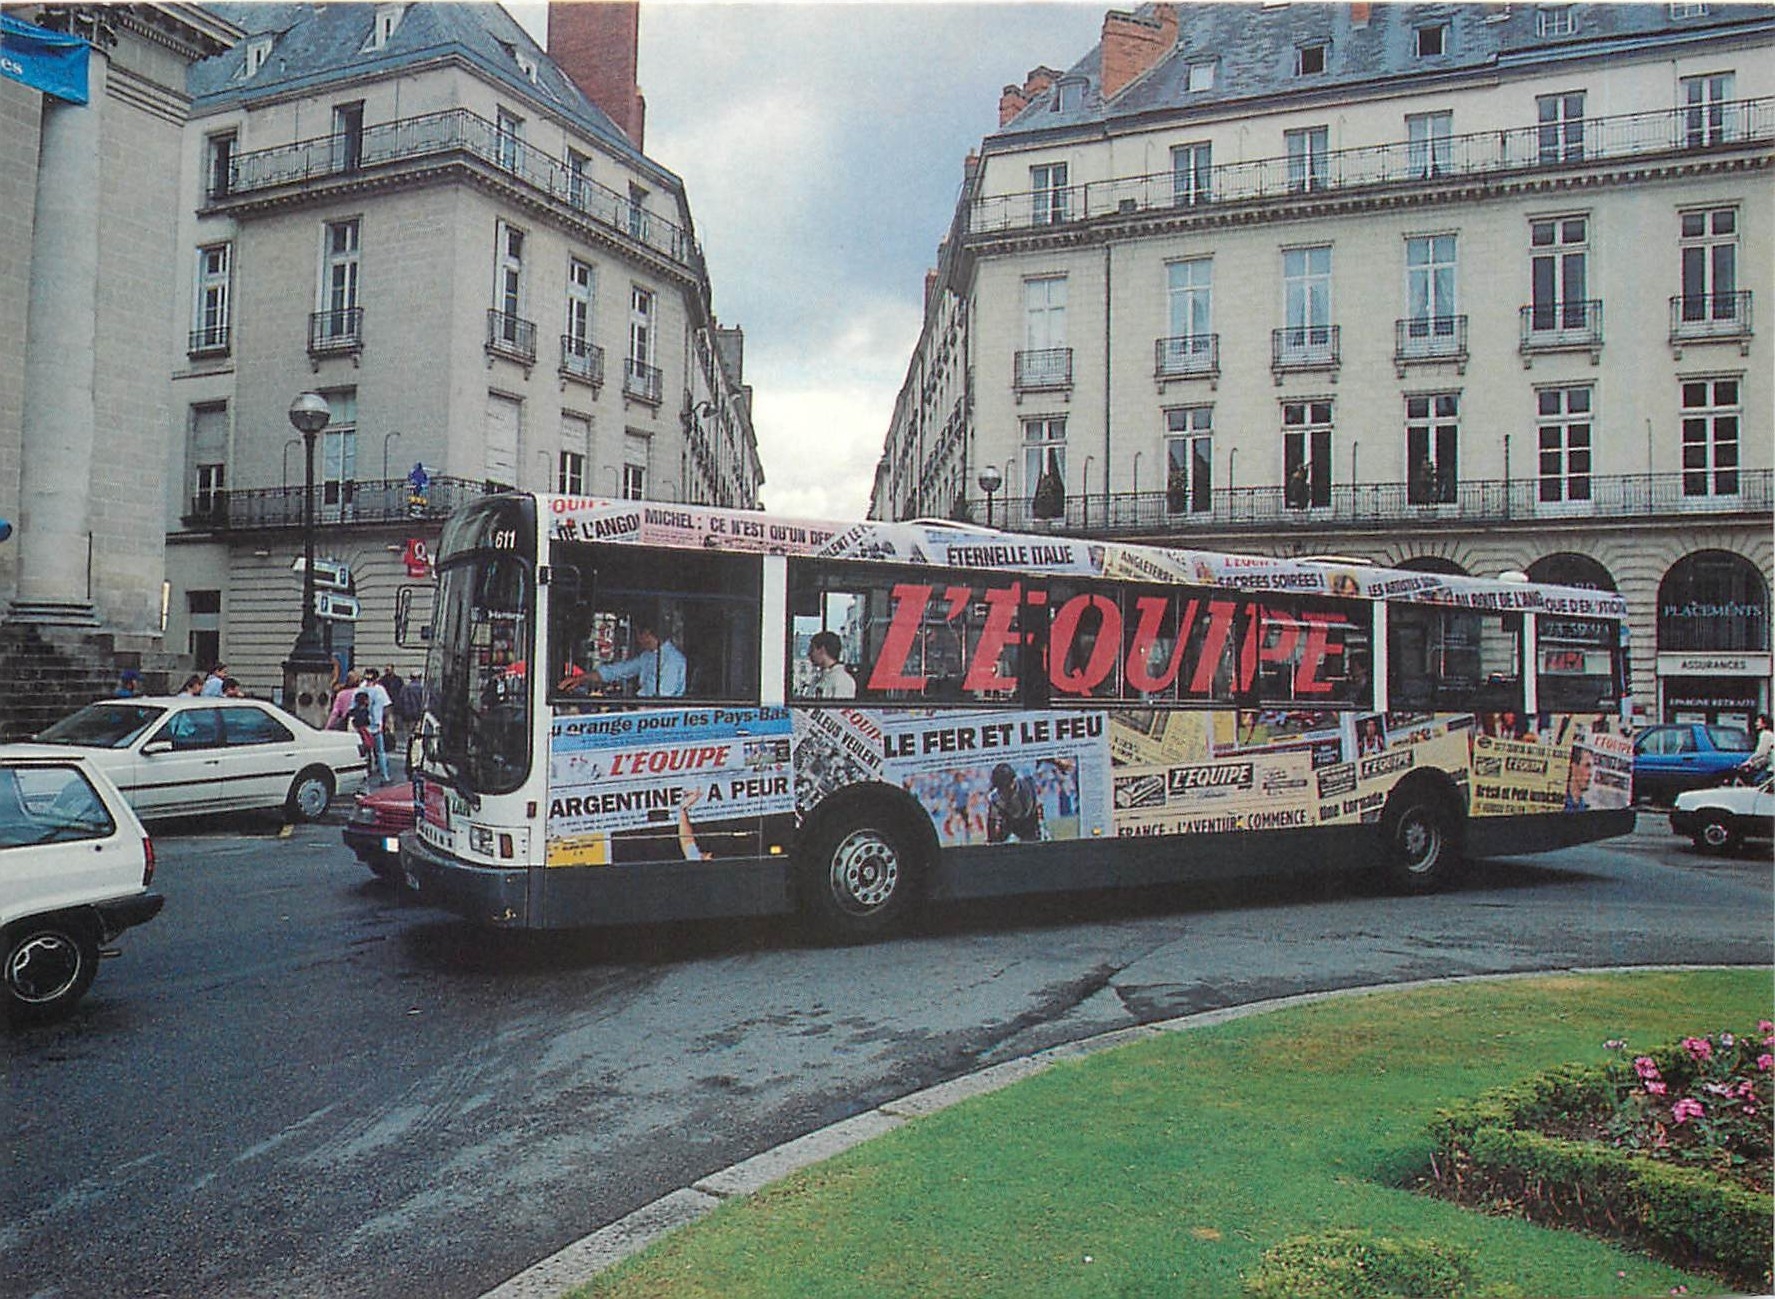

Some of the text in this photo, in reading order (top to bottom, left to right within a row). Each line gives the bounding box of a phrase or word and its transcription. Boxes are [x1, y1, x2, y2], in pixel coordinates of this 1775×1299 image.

[495, 529, 515, 549] 611
[731, 519, 766, 539] N'EST
[770, 523, 806, 543] QU'UN
[1031, 545, 1075, 565] ITALIE
[1498, 592, 1513, 607] DE
[1664, 601, 1762, 617] PLACEMENTS
[1681, 659, 1746, 670] ASSURANCES
[567, 714, 632, 736] orange
[637, 711, 680, 735] pour
[683, 707, 708, 726] les
[810, 708, 842, 738] BLEUS
[841, 731, 881, 769] VEULENT
[884, 731, 915, 758] LE
[922, 727, 977, 754] FER
[982, 723, 1014, 748] ET
[1020, 720, 1049, 744] LE
[1055, 714, 1103, 741] FEU
[549, 787, 684, 819] ARGENTINE
[707, 783, 727, 802] A
[731, 777, 789, 800] PEUR
[1118, 809, 1308, 838] FRANCE L'AVENTURE COMMENCE
